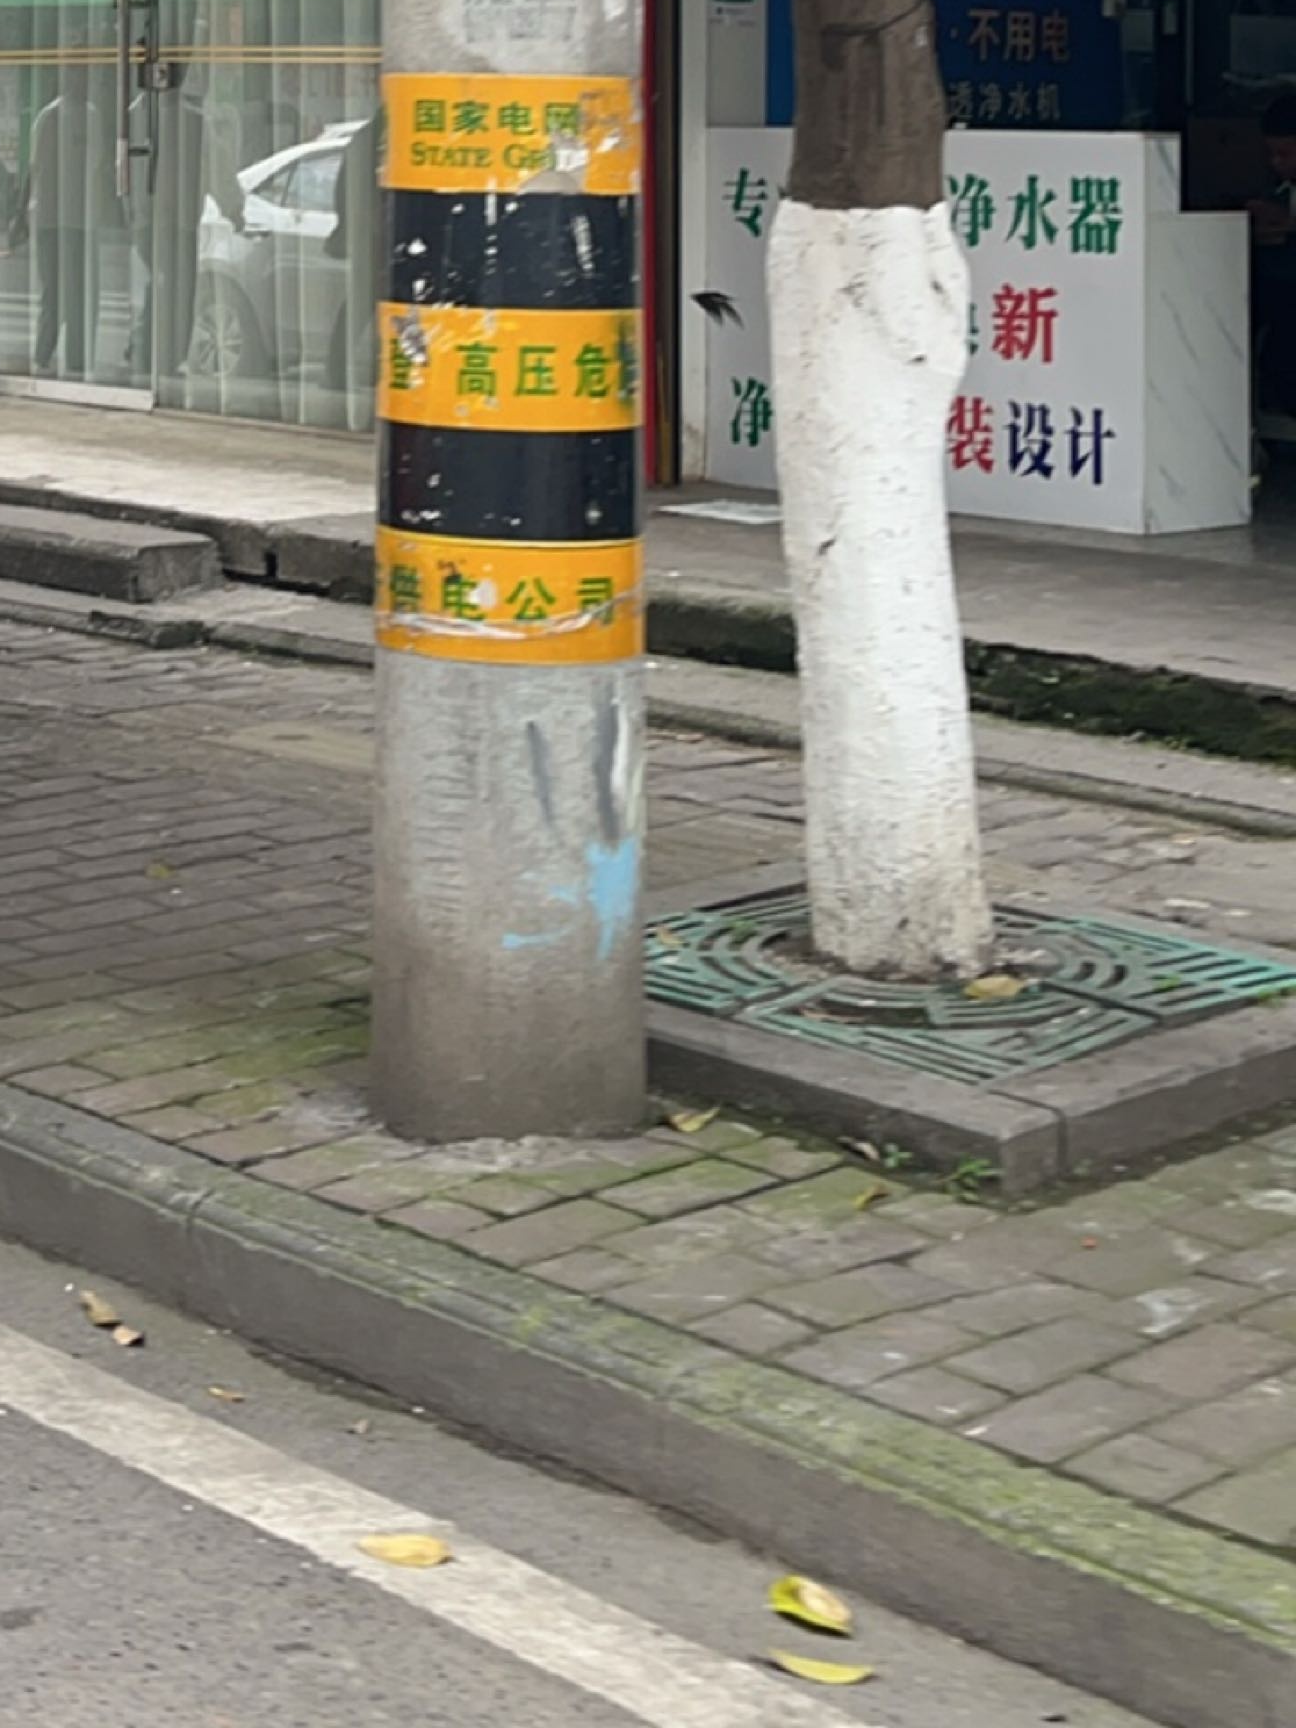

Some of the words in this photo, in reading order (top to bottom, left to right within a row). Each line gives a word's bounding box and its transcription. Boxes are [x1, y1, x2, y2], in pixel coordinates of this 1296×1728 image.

[945, 173, 1124, 256] 净水器
[968, 283, 1061, 365] 新
[454, 339, 636, 403] 高压危
